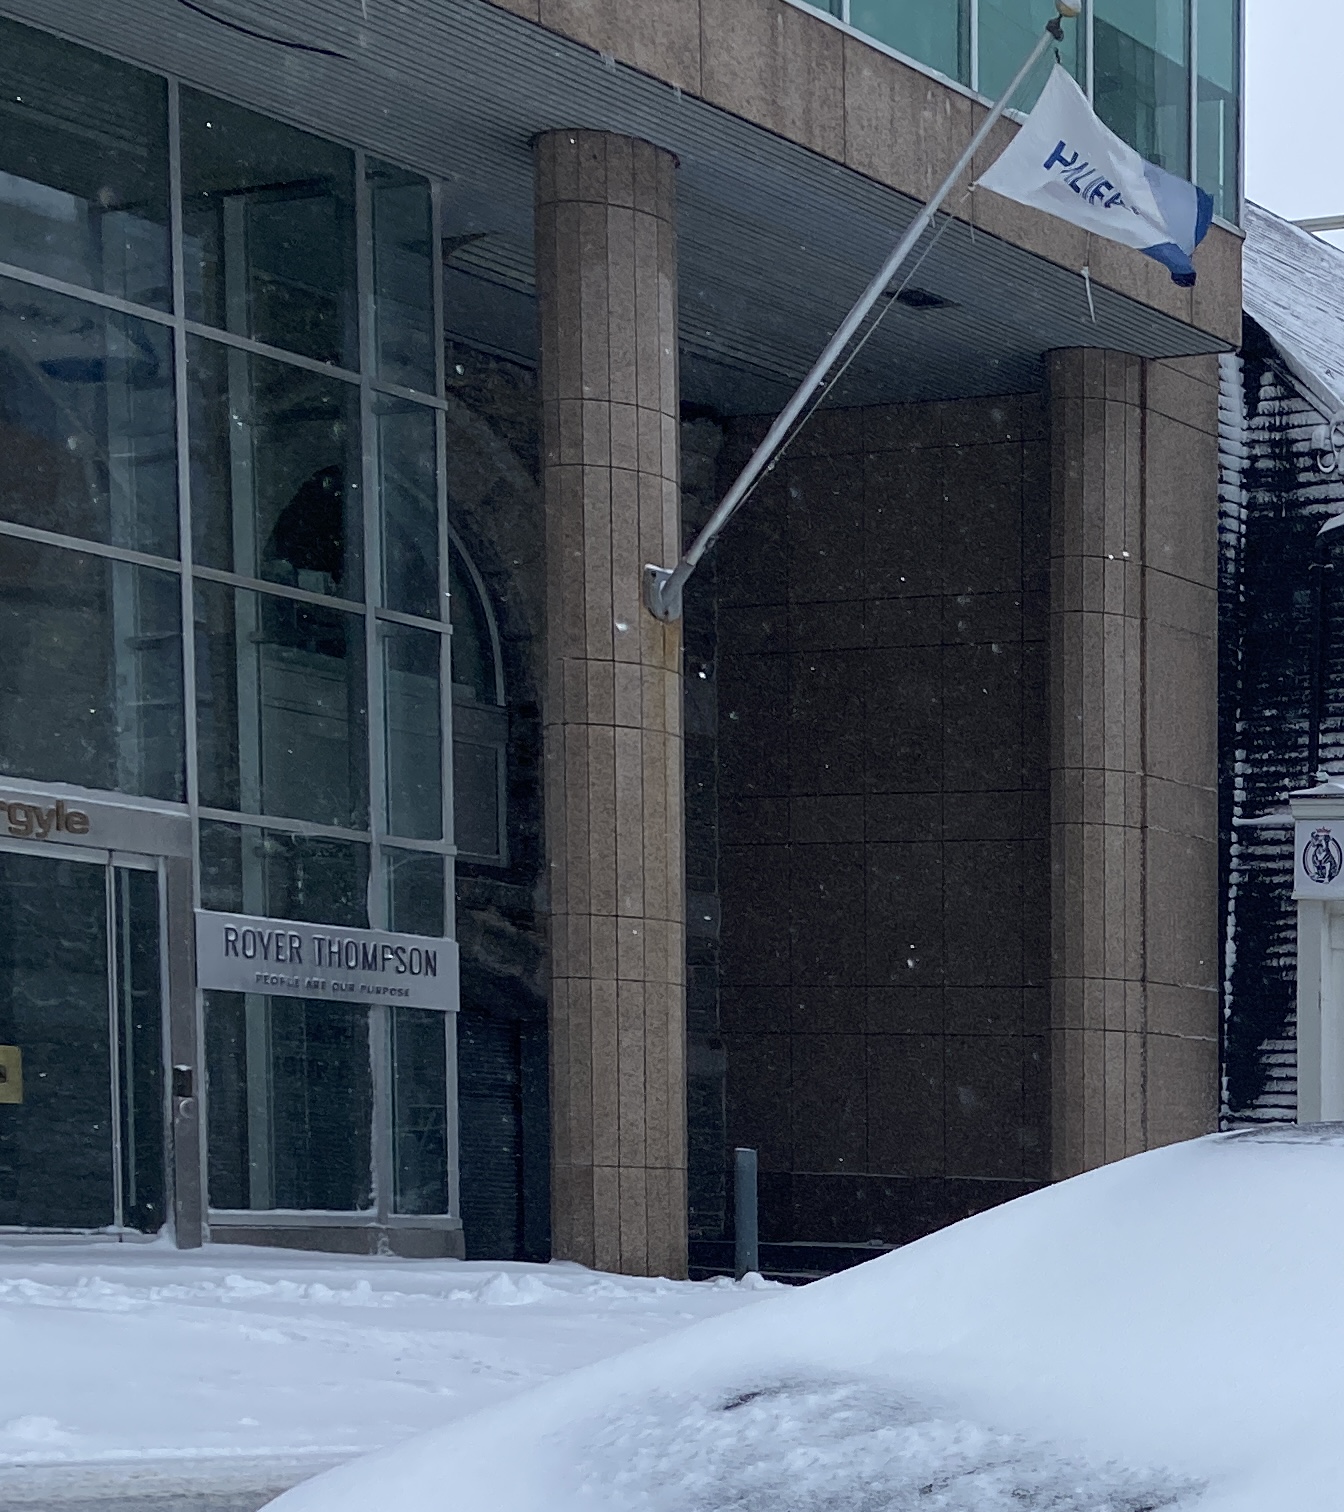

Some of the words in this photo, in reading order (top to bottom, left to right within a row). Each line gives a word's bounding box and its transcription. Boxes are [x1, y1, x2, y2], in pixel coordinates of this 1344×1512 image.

[223, 924, 303, 965] ROYER
[312, 934, 438, 977] THOMPSON
[255, 972, 300, 989] PEOPLE
[304, 976, 327, 991] ARE
[332, 981, 355, 993] OUR
[360, 984, 410, 997] PURPOSE
